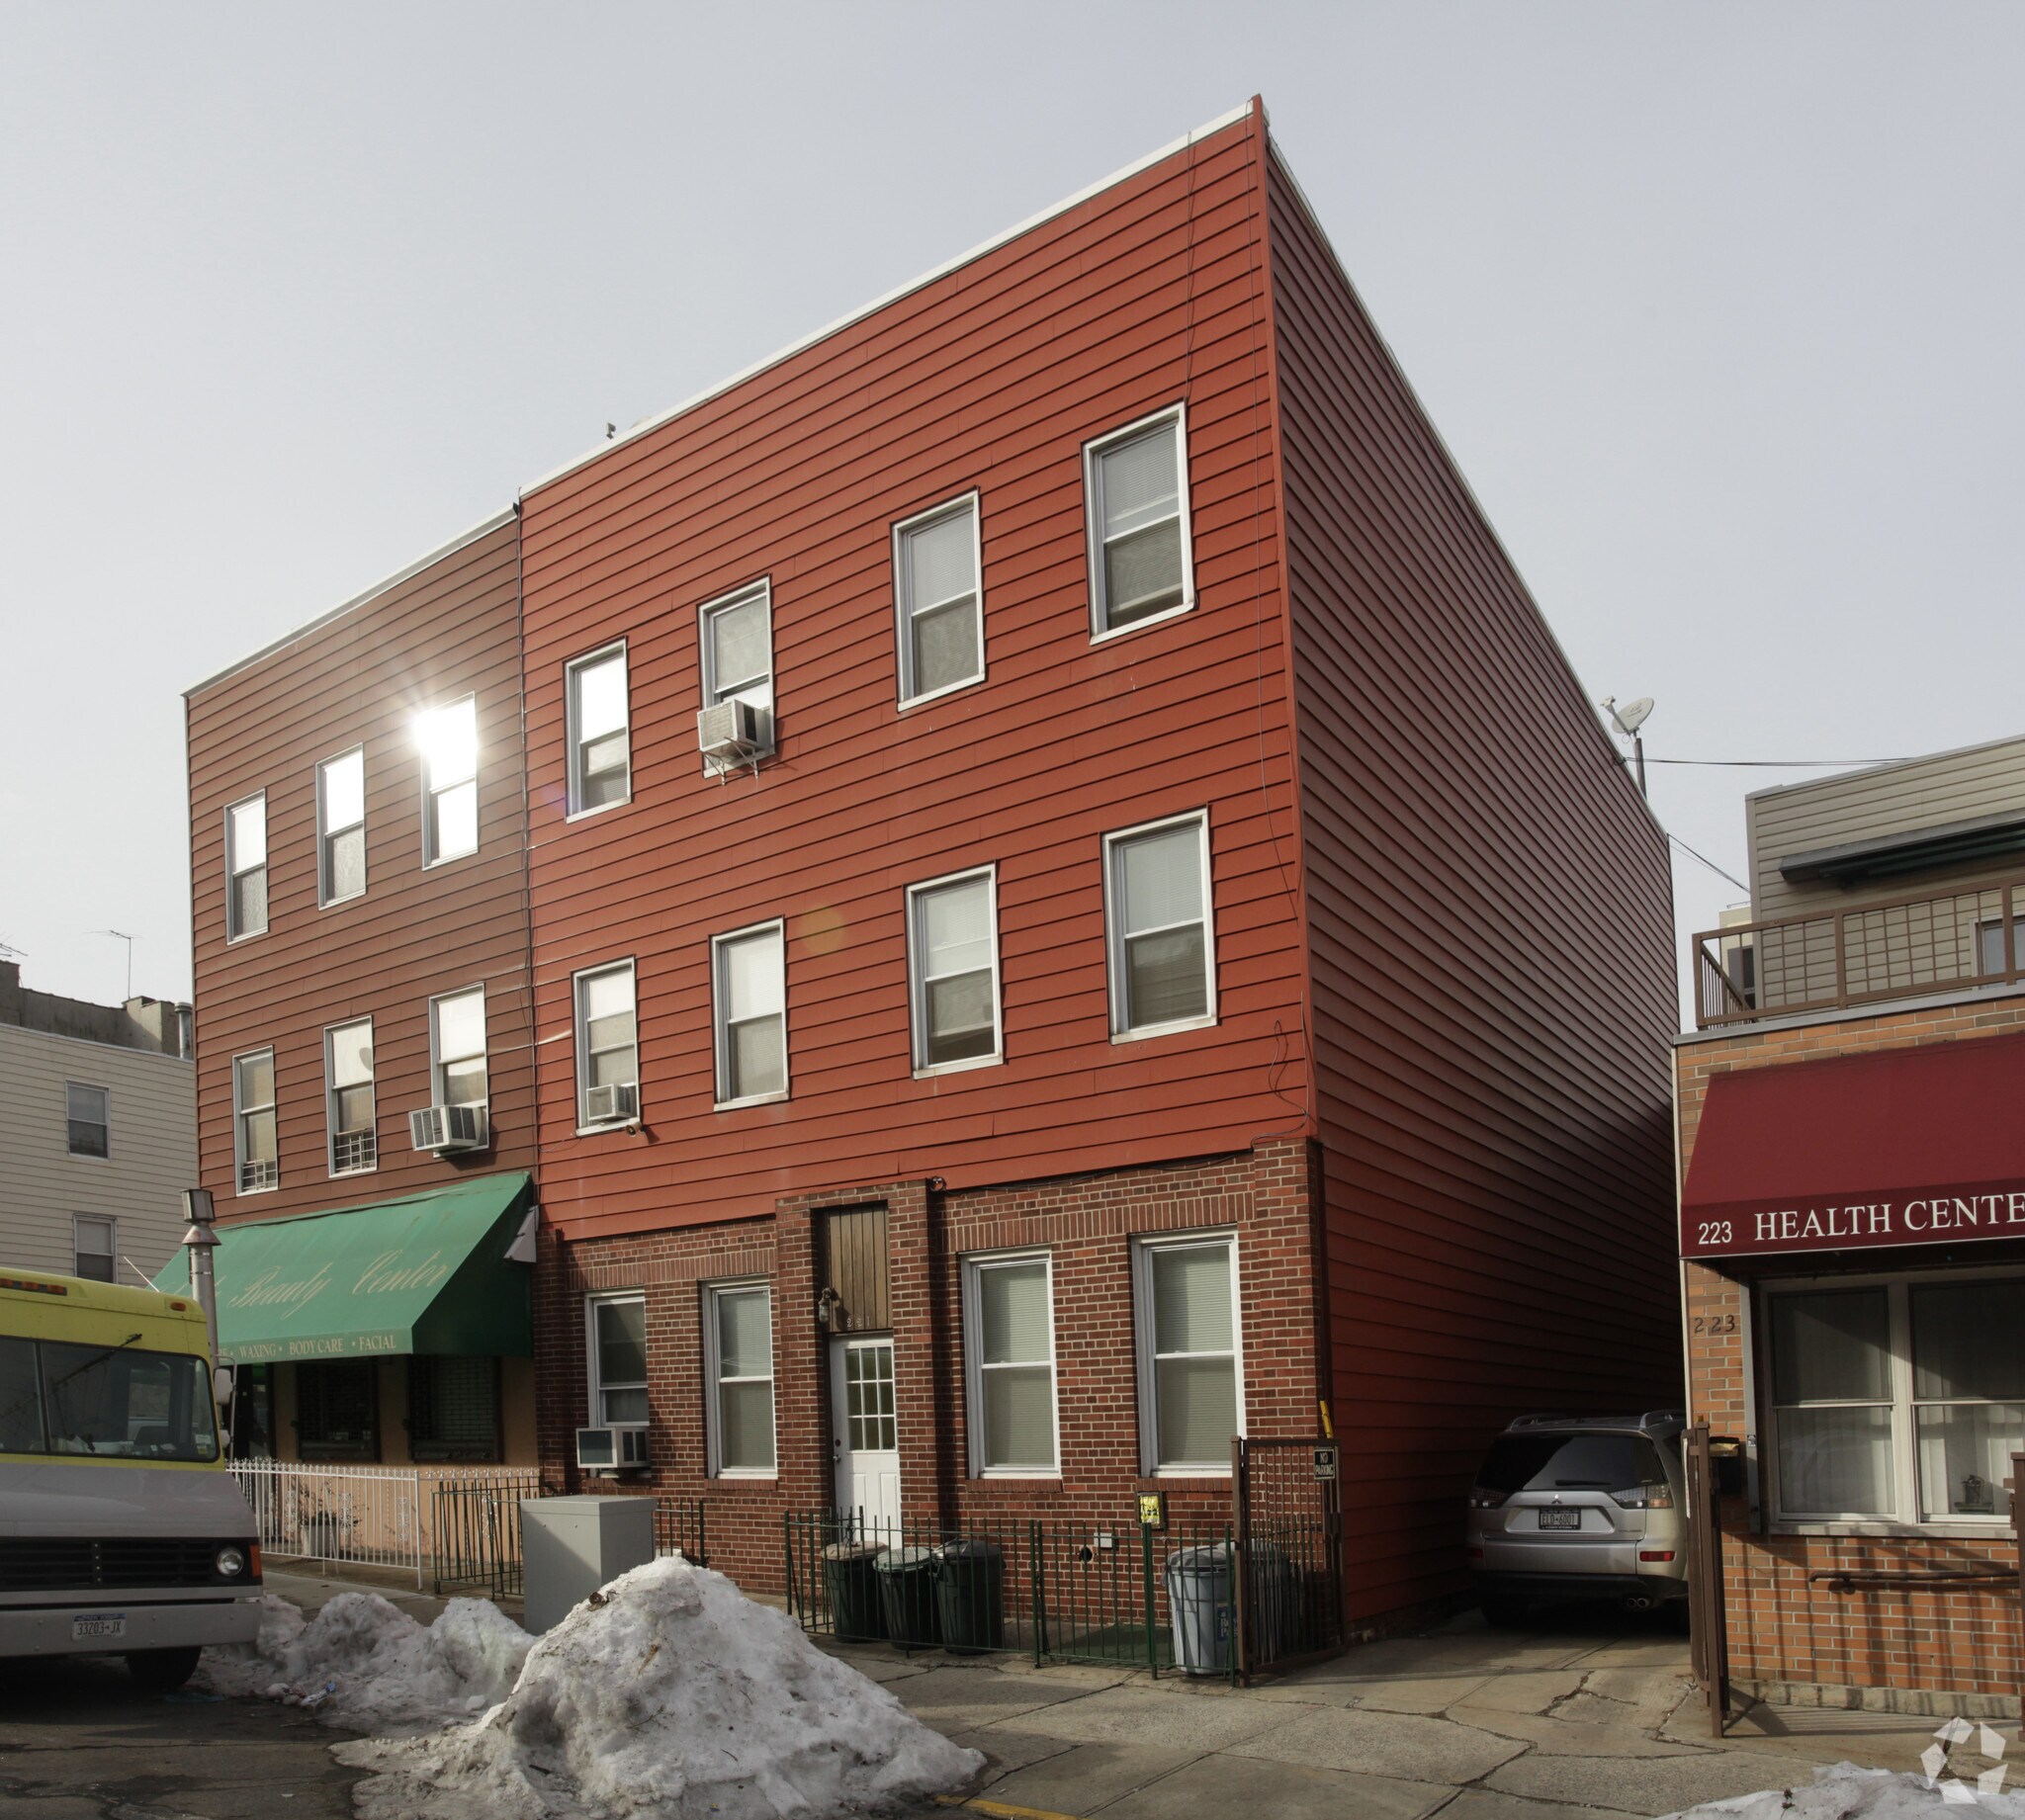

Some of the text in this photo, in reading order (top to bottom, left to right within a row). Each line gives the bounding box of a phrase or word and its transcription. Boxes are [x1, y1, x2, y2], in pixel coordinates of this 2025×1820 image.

[1698, 1221, 1732, 1245] 223
[1754, 1203, 1893, 1242] HEALTH
[227, 1261, 334, 1321] Beauty
[352, 1249, 452, 1296] Center
[846, 1315, 871, 1328] 221
[1694, 1315, 1735, 1335] 223
[239, 1343, 277, 1359] WAXING
[289, 1340, 316, 1355] BODY
[317, 1338, 344, 1353] CARE
[359, 1335, 396, 1350] FACIAL
[1320, 1451, 1329, 1463] NO
[1315, 1464, 1334, 1475] PARKING
